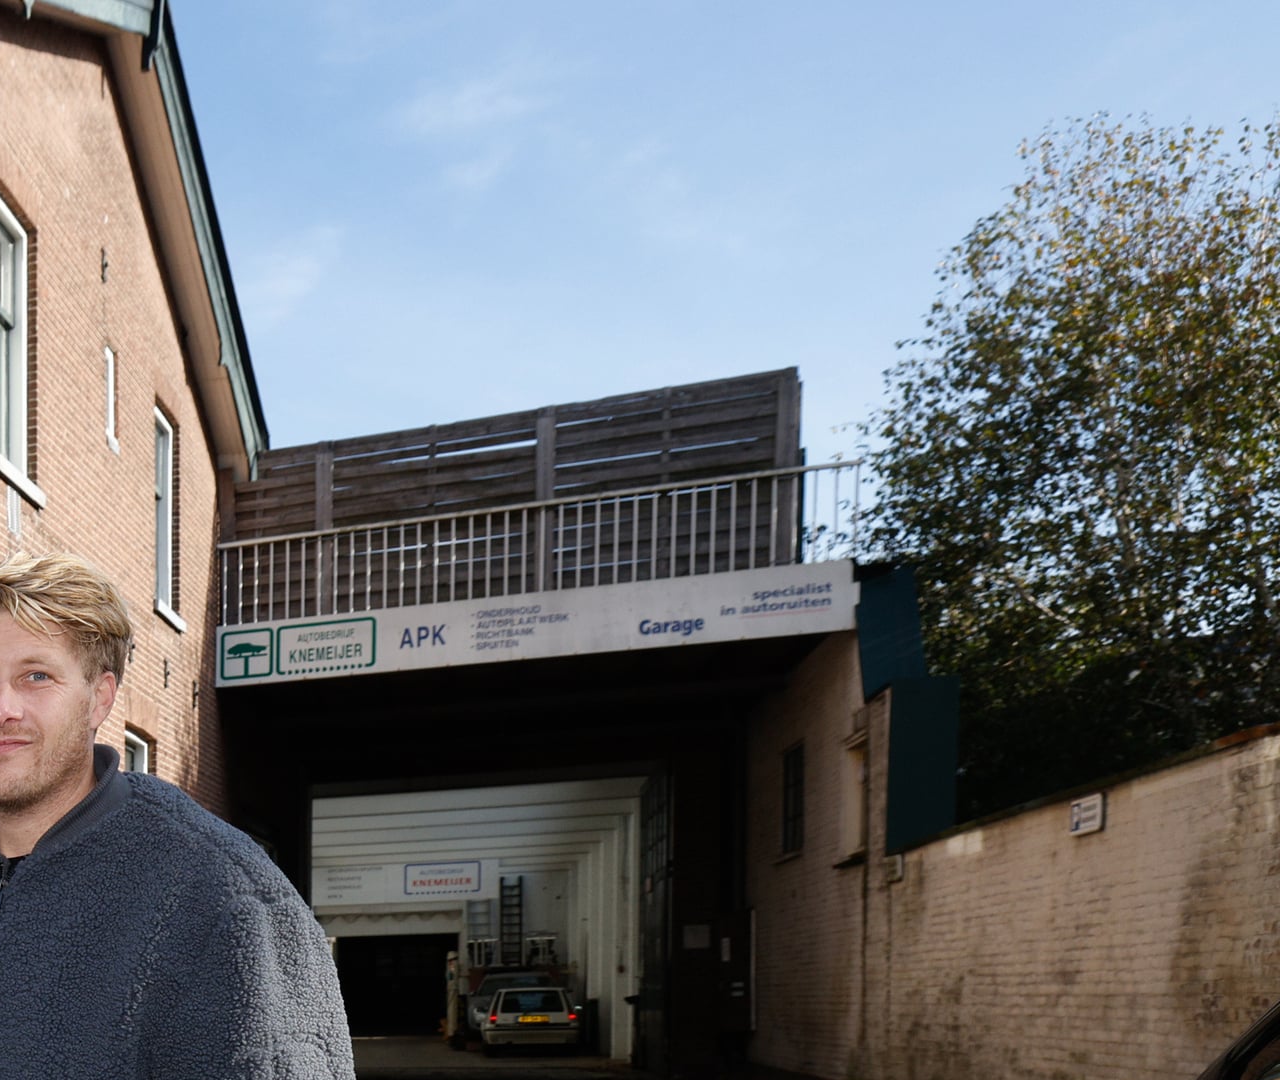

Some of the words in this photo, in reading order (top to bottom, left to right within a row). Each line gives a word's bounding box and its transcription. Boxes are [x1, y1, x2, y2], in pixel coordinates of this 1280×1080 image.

[752, 583, 832, 601] specialist
[720, 605, 736, 616] in
[742, 597, 832, 614] autoruiten
[297, 628, 355, 643] AUTOBEDRIJF
[639, 617, 705, 636] Garage
[399, 624, 447, 649] APK
[289, 643, 363, 664] KNEMEIJER
